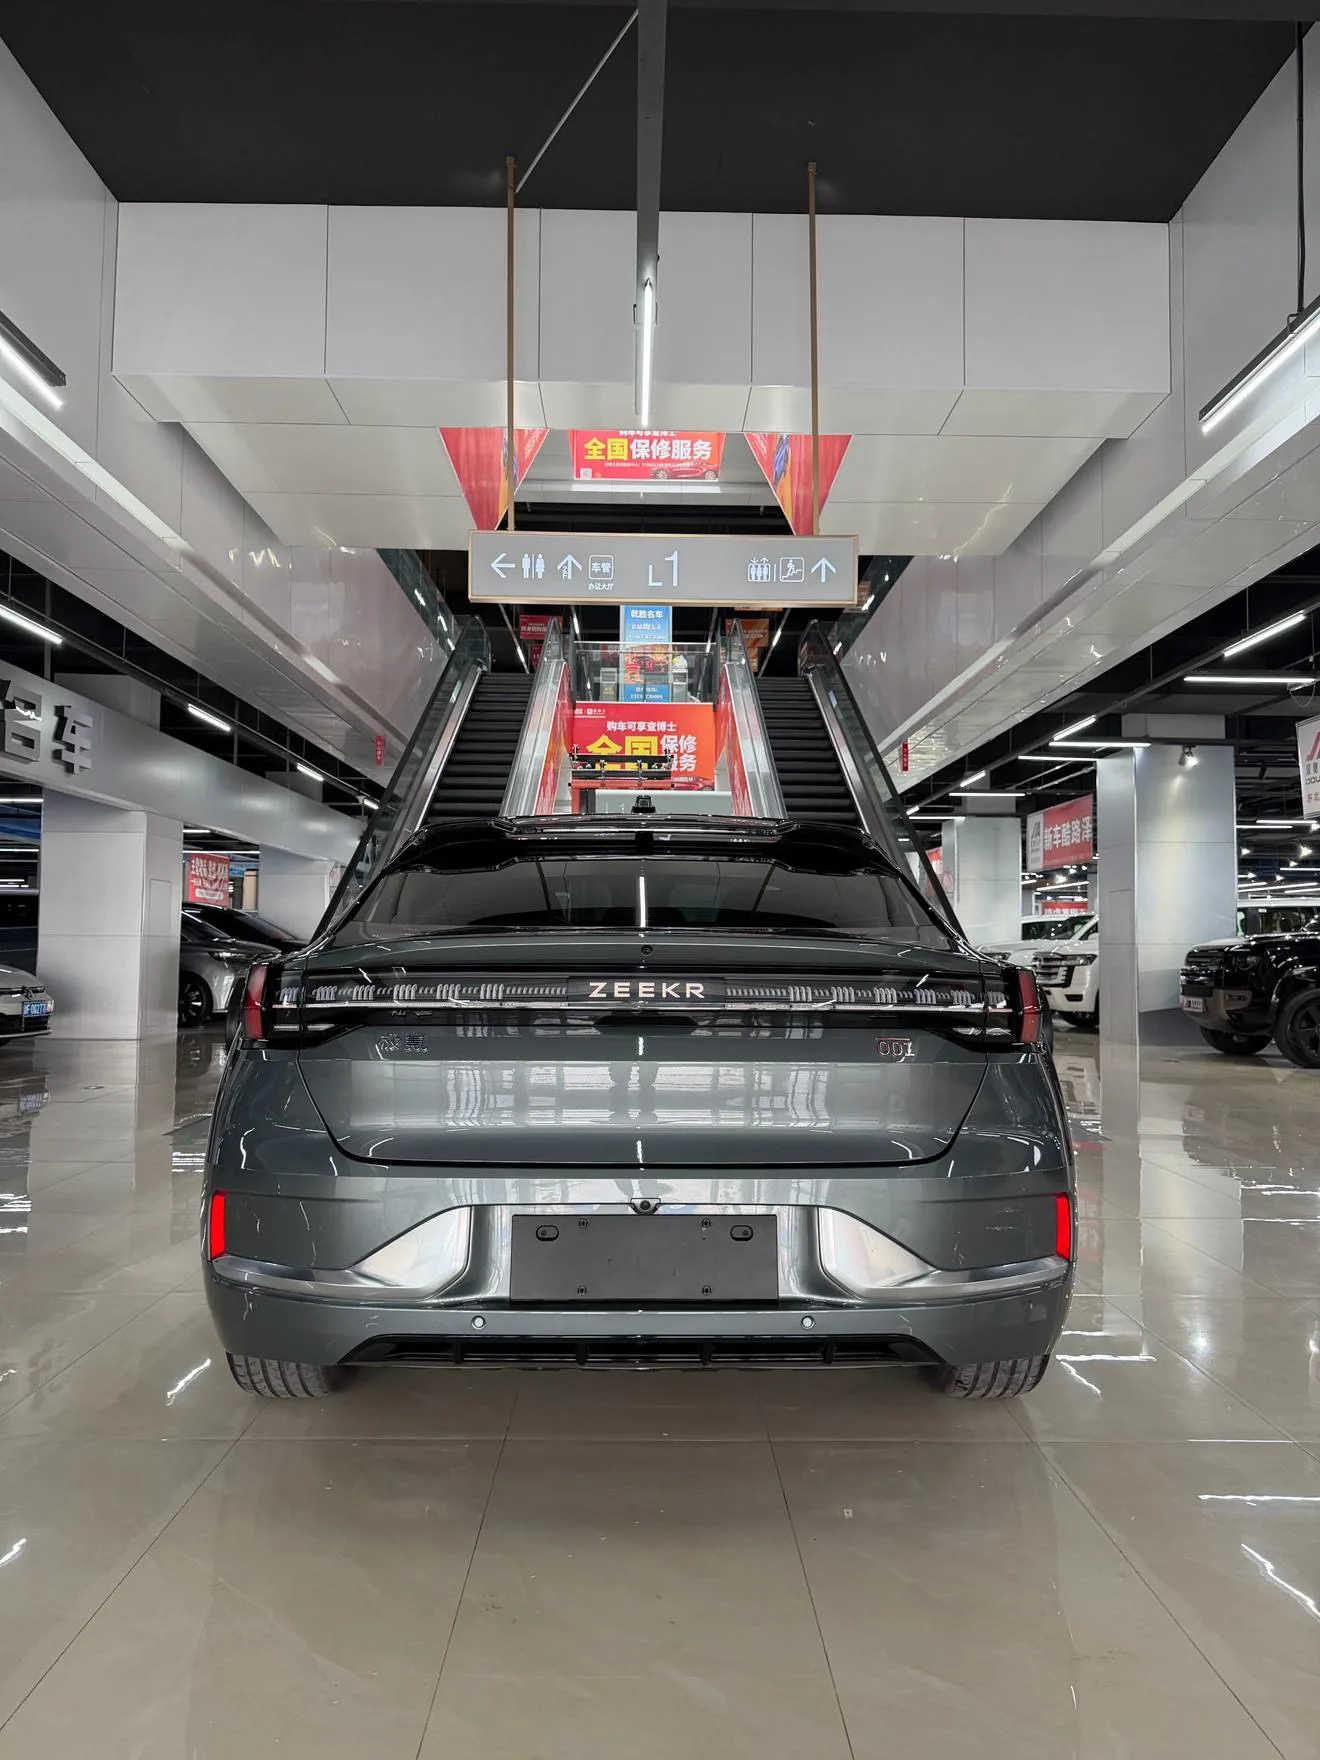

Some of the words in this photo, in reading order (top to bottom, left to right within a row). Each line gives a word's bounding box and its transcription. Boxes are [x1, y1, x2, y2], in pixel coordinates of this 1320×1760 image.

[583, 437, 713, 461] 全国保修服务
[591, 562, 612, 573] 车管
[606, 720, 678, 732] 购车可享查博士
[1044, 816, 1093, 851] 新车酷路泽
[588, 982, 705, 998] ZEEKR
